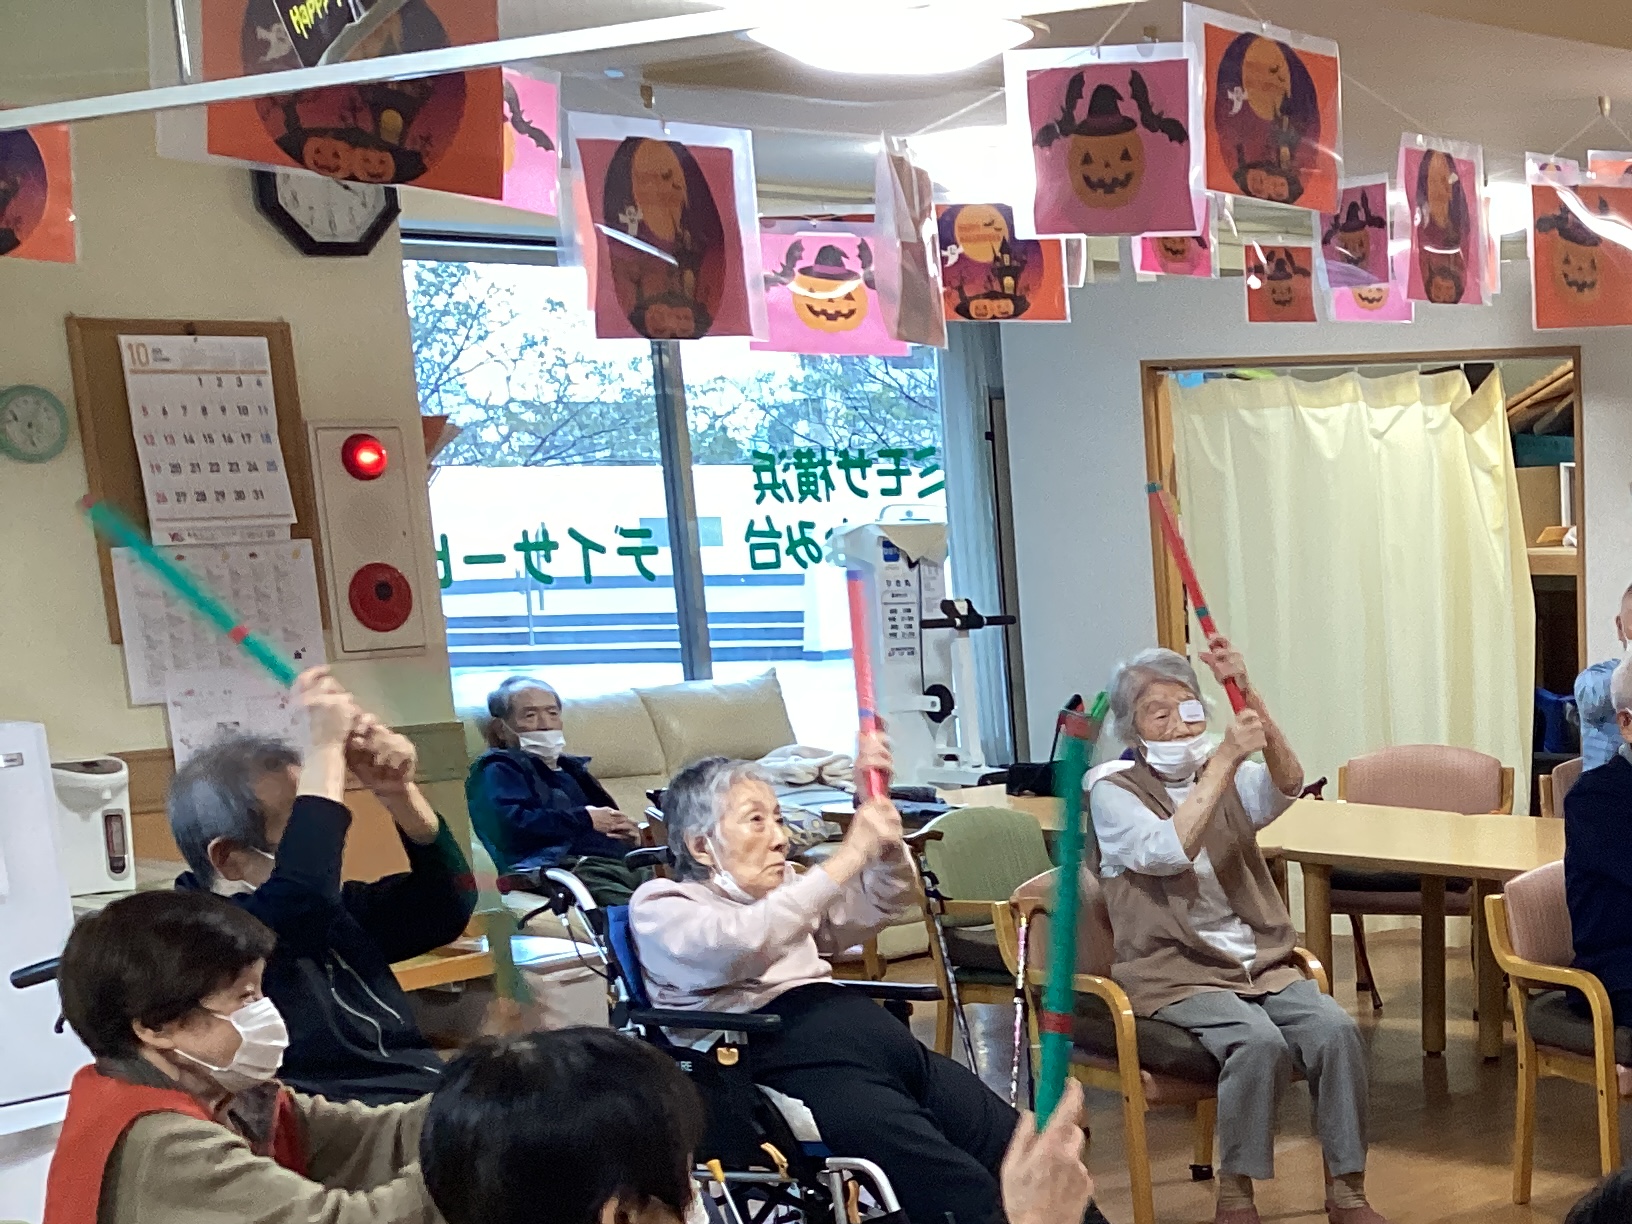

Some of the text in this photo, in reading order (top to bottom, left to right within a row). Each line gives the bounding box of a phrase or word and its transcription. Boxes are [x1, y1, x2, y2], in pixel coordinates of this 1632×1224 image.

[128, 343, 150, 367] 10
[198, 376, 203, 388] 1
[216, 376, 223, 388] 2
[235, 376, 243, 388] 3
[162, 405, 168, 417] 6
[180, 404, 187, 416] 7
[201, 405, 208, 417] 8
[220, 405, 227, 416] 9
[236, 405, 249, 416] 10
[258, 405, 268, 416] 11
[143, 433, 156, 446] 12
[183, 433, 195, 444] 14
[202, 433, 215, 444] 15
[222, 433, 234, 444] 16
[241, 432, 252, 444] 17
[260, 432, 272, 444] 18
[169, 462, 181, 474] 20
[189, 462, 201, 474] 21
[208, 462, 221, 473] 22
[228, 461, 240, 473] 23
[246, 461, 259, 472] 24
[175, 491, 187, 503] 27
[194, 490, 207, 502] 28
[214, 490, 225, 502] 29
[234, 489, 246, 501] 30
[253, 489, 264, 500] 31
